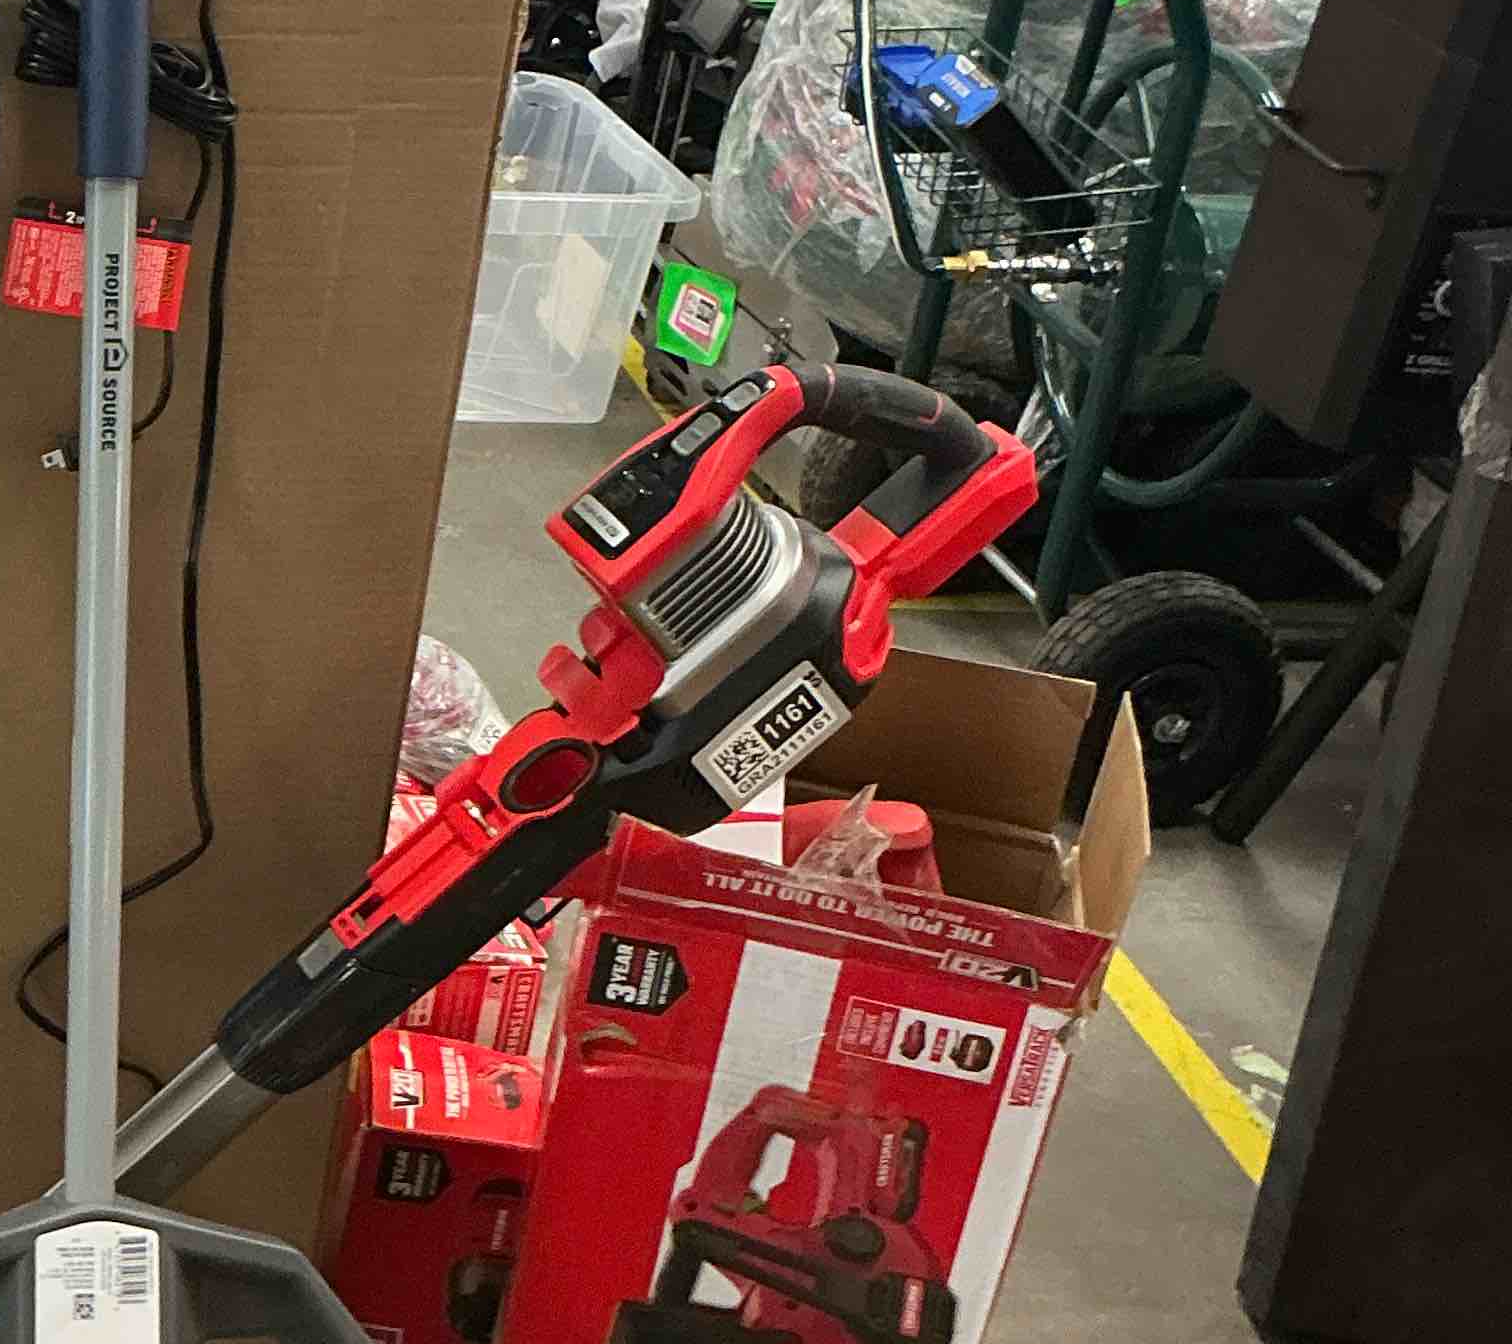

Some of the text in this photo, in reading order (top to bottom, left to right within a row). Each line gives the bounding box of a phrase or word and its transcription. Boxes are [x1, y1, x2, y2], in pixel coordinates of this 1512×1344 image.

[101, 253, 121, 451] PROJECT SOURCE
[763, 694, 814, 740] 1161
[738, 712, 833, 795] GRA2111161
[702, 871, 746, 893] ALL
[749, 879, 774, 899] IT
[776, 886, 814, 908] DO
[817, 894, 849, 916] TO
[945, 921, 997, 948] THE
[605, 943, 637, 1004] 3 YEAR
